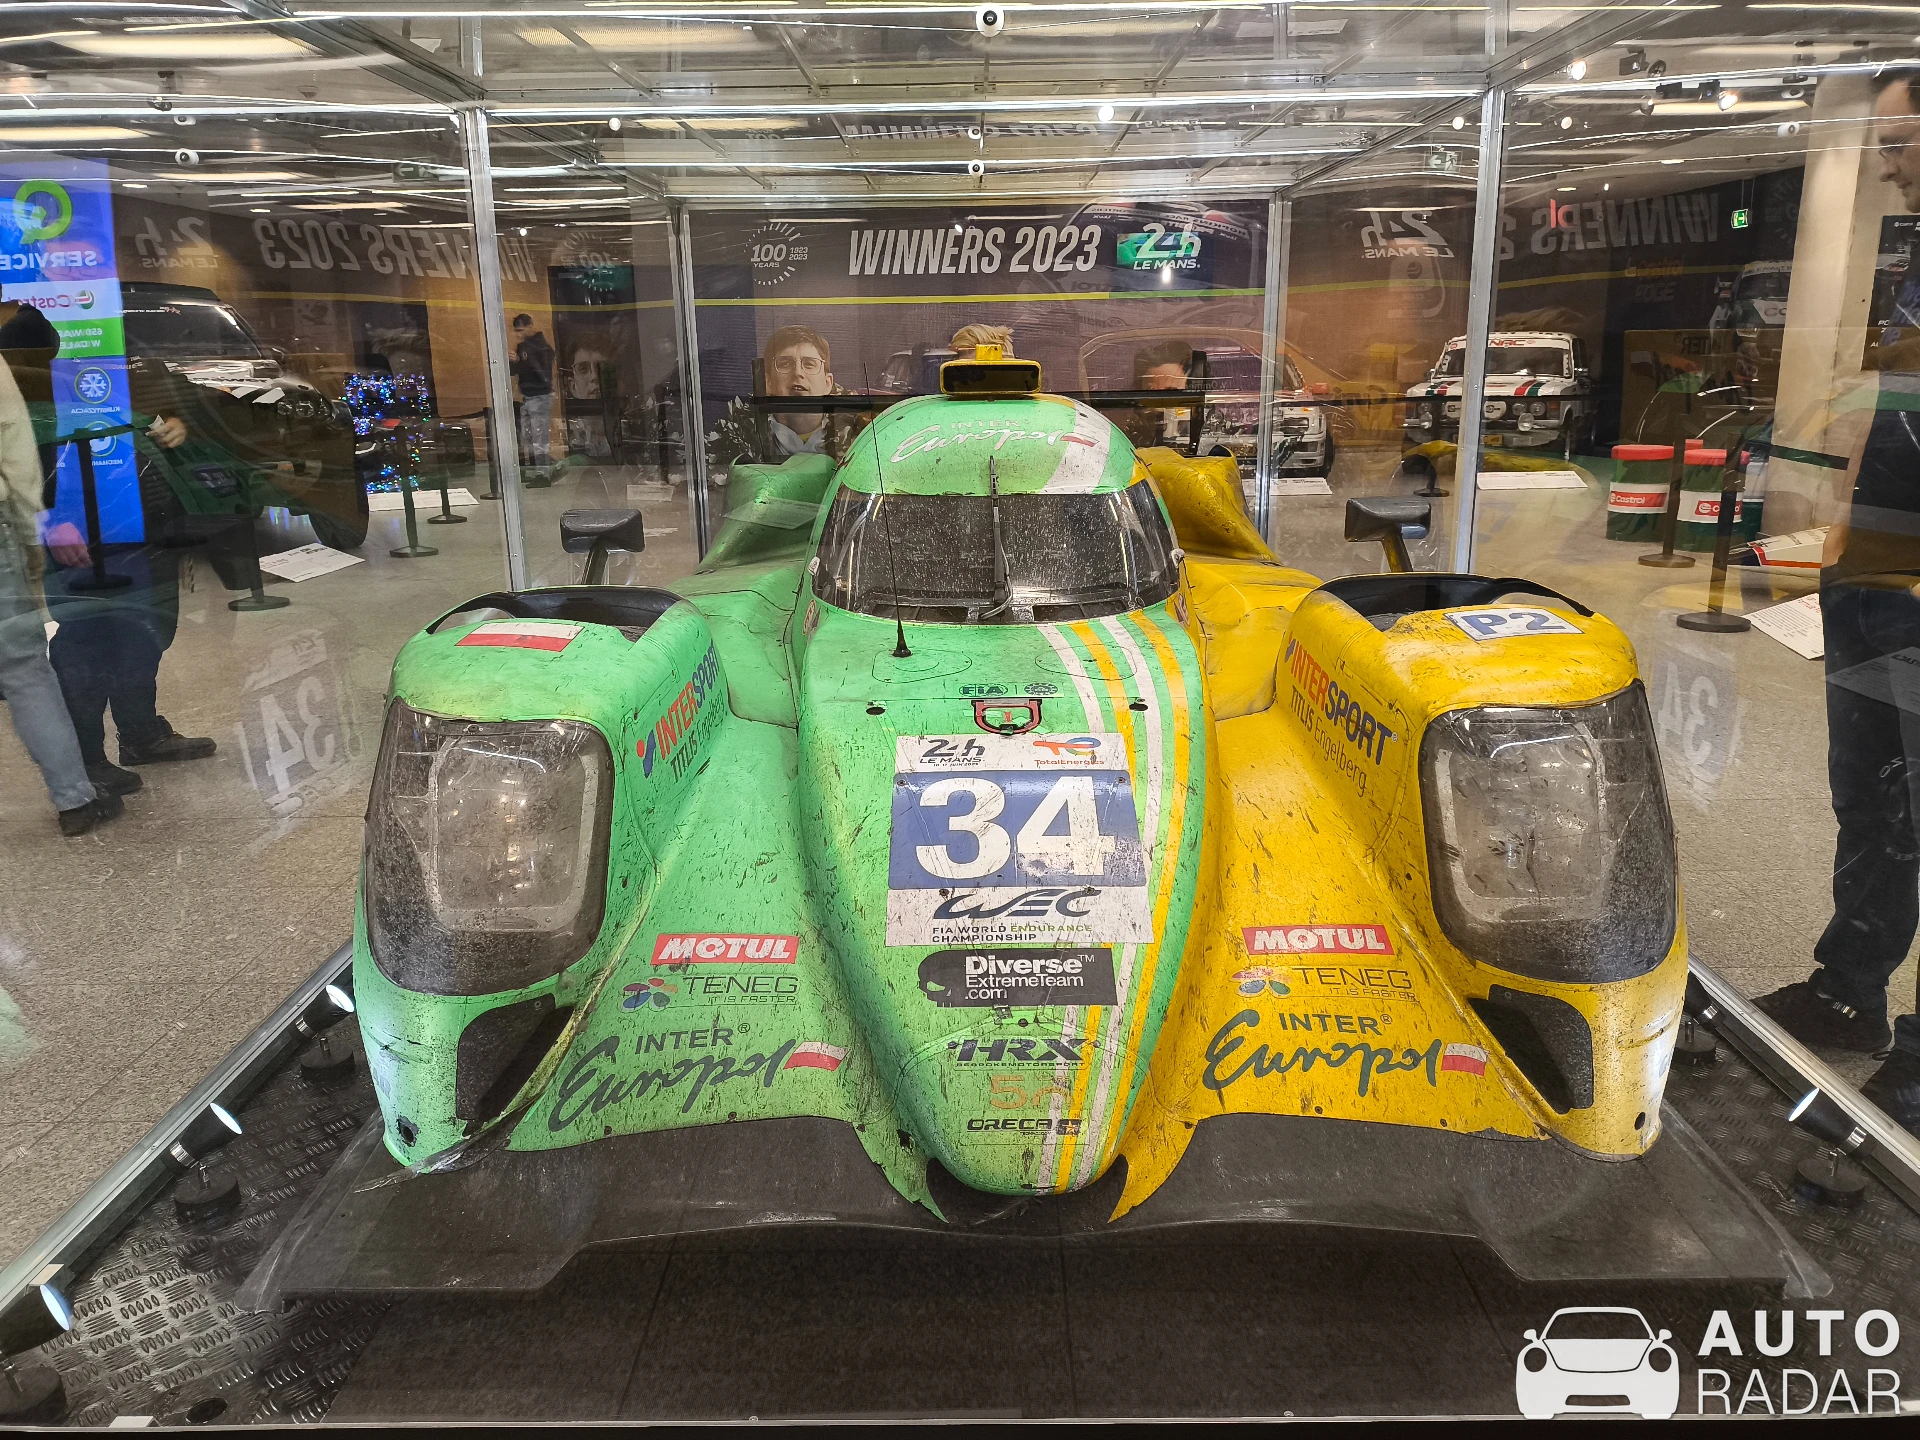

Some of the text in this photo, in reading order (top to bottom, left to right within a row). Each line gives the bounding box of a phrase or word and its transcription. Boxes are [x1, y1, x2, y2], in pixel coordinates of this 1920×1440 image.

[750, 244, 787, 262] 100
[789, 246, 808, 254] 1923
[789, 253, 808, 261] 2023
[848, 225, 1102, 276] WINNERS 2023
[1133, 260, 1153, 271] LE
[890, 424, 1063, 463] Europol
[1616, 494, 1645, 505] Castrol
[1461, 612, 1566, 635] P2
[655, 639, 720, 761] INTERSPORT
[1291, 684, 1368, 798] TITLIS Engelberg
[916, 776, 1116, 879] 34
[932, 888, 1102, 920] WEC
[932, 924, 1093, 935] FIA WORLD ENDURANCE
[932, 934, 1037, 943] CHAMPIONSHIP
[1254, 928, 1386, 951] MOTUL
[659, 937, 791, 960] MOTUL
[684, 976, 799, 995] TENEG
[965, 974, 1084, 988] ExtremeTeam
[1292, 968, 1413, 990] TENEG
[741, 996, 796, 1004] FASTER
[964, 987, 1008, 1000] .com
[1362, 989, 1417, 1000] FASTER
[957, 1038, 1089, 1061] HRX
[1202, 1009, 1442, 1097] Europol
[548, 1036, 797, 1131] Europol
[967, 1119, 1053, 1131] ORECA
